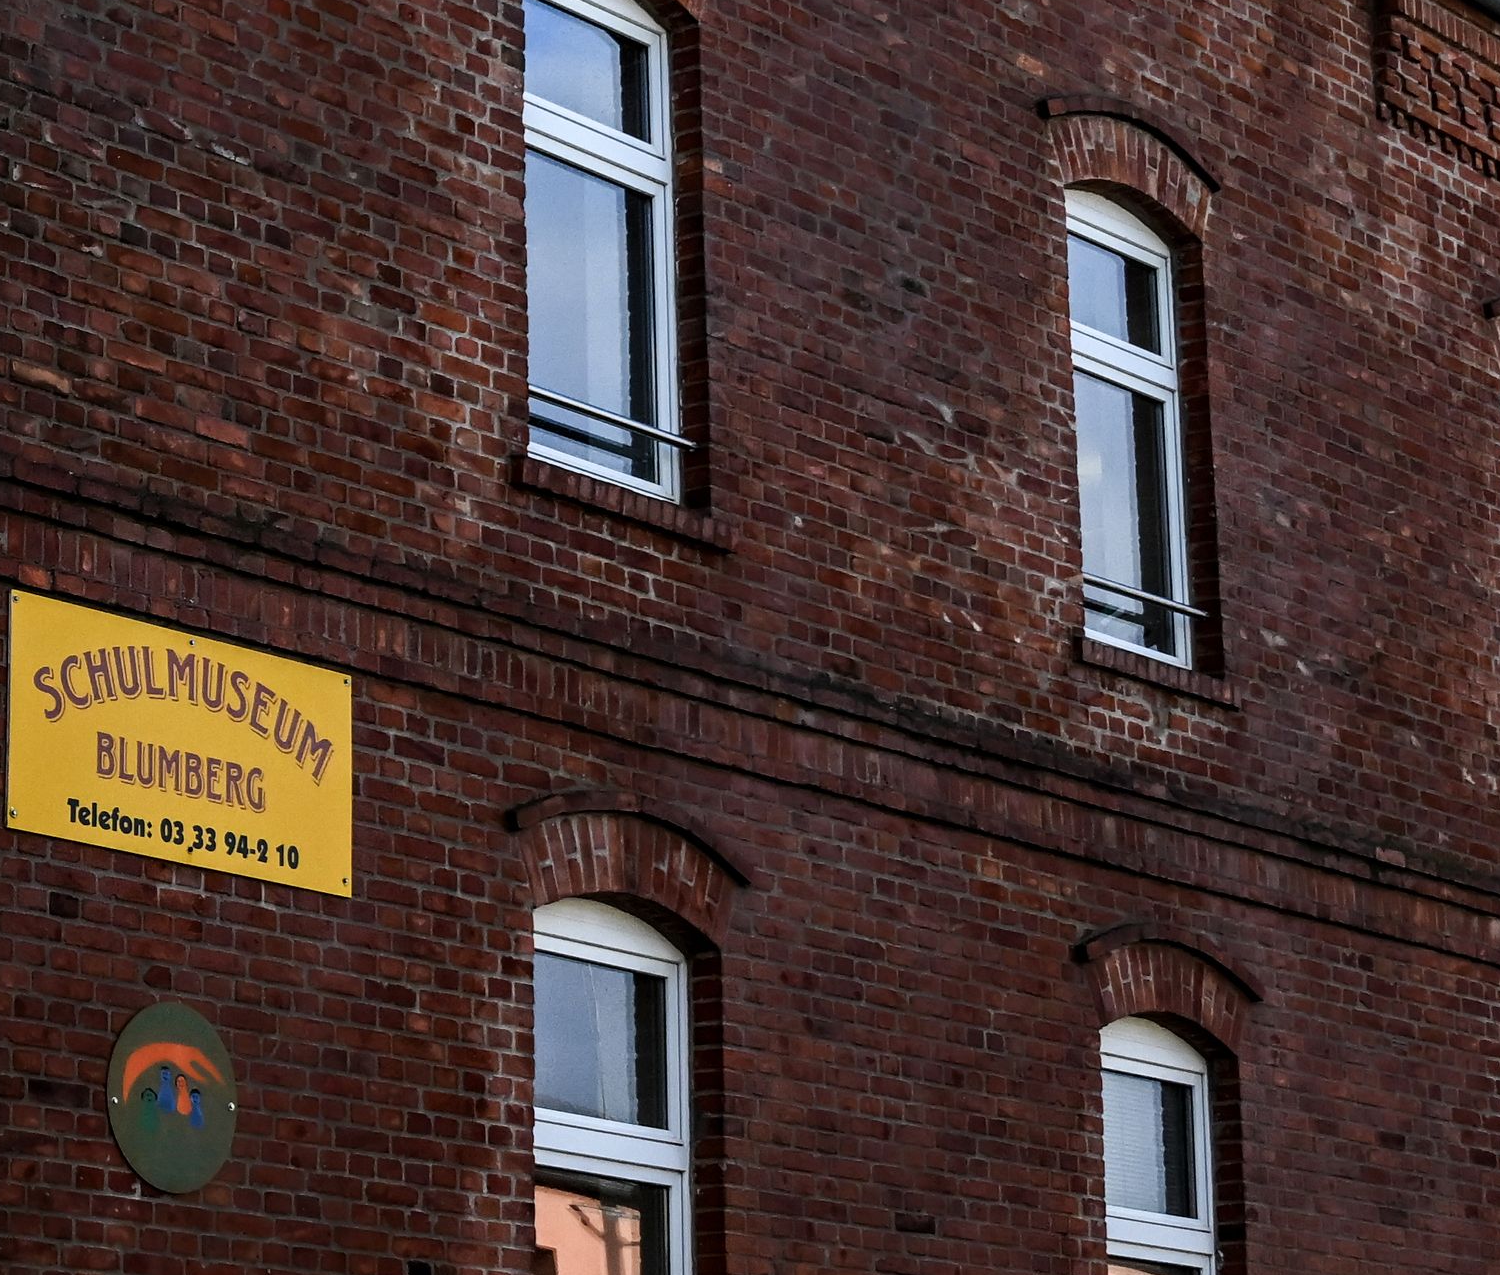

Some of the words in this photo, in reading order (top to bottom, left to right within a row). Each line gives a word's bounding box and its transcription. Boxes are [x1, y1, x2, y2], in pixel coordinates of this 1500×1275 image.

[33, 645, 334, 785] SCHULMUSEUM
[96, 731, 266, 813] BLUMBERG
[67, 797, 153, 839] Telefon:
[276, 843, 300, 869] 10
